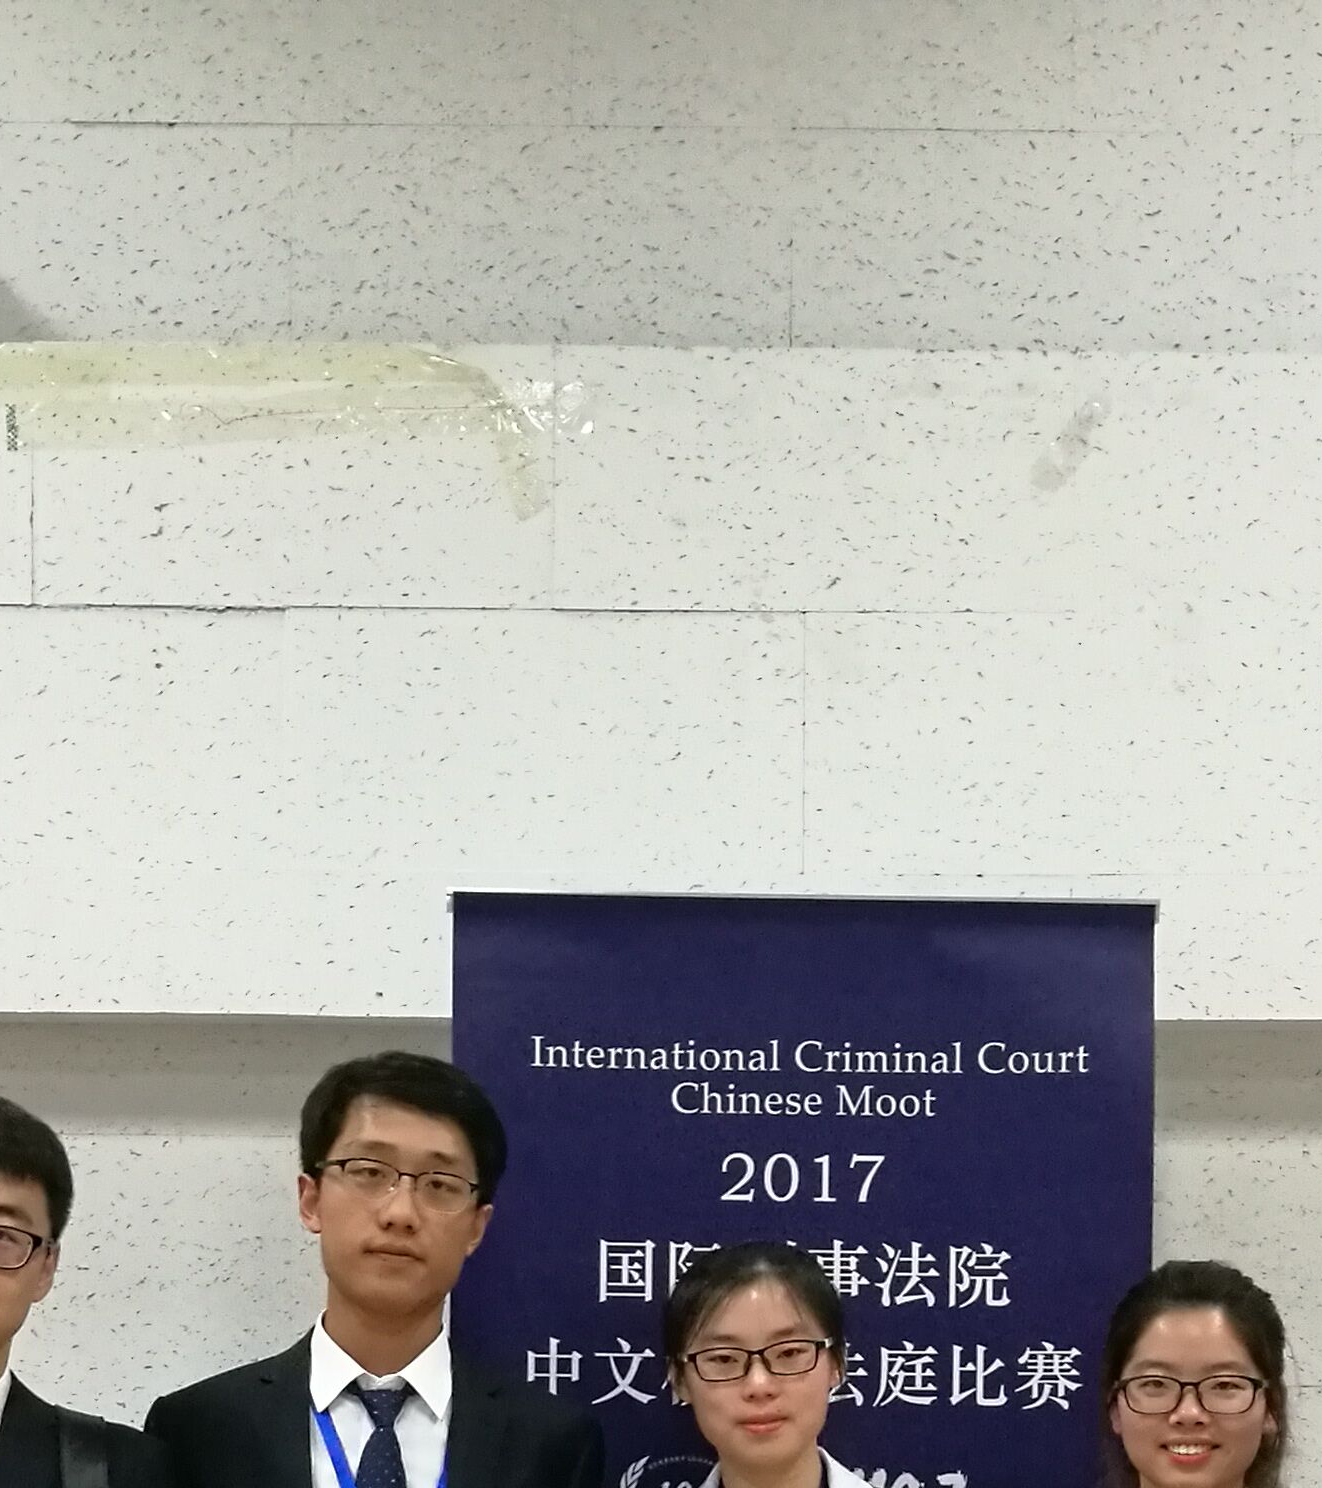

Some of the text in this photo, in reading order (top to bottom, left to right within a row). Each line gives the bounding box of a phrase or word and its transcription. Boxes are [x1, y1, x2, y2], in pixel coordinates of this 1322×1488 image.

[530, 1035, 1090, 1075] International Criminal Court
[671, 1081, 937, 1119] Chinese Moot
[719, 1151, 887, 1204] 2017
[599, 1239, 1012, 1308] 国事法院
